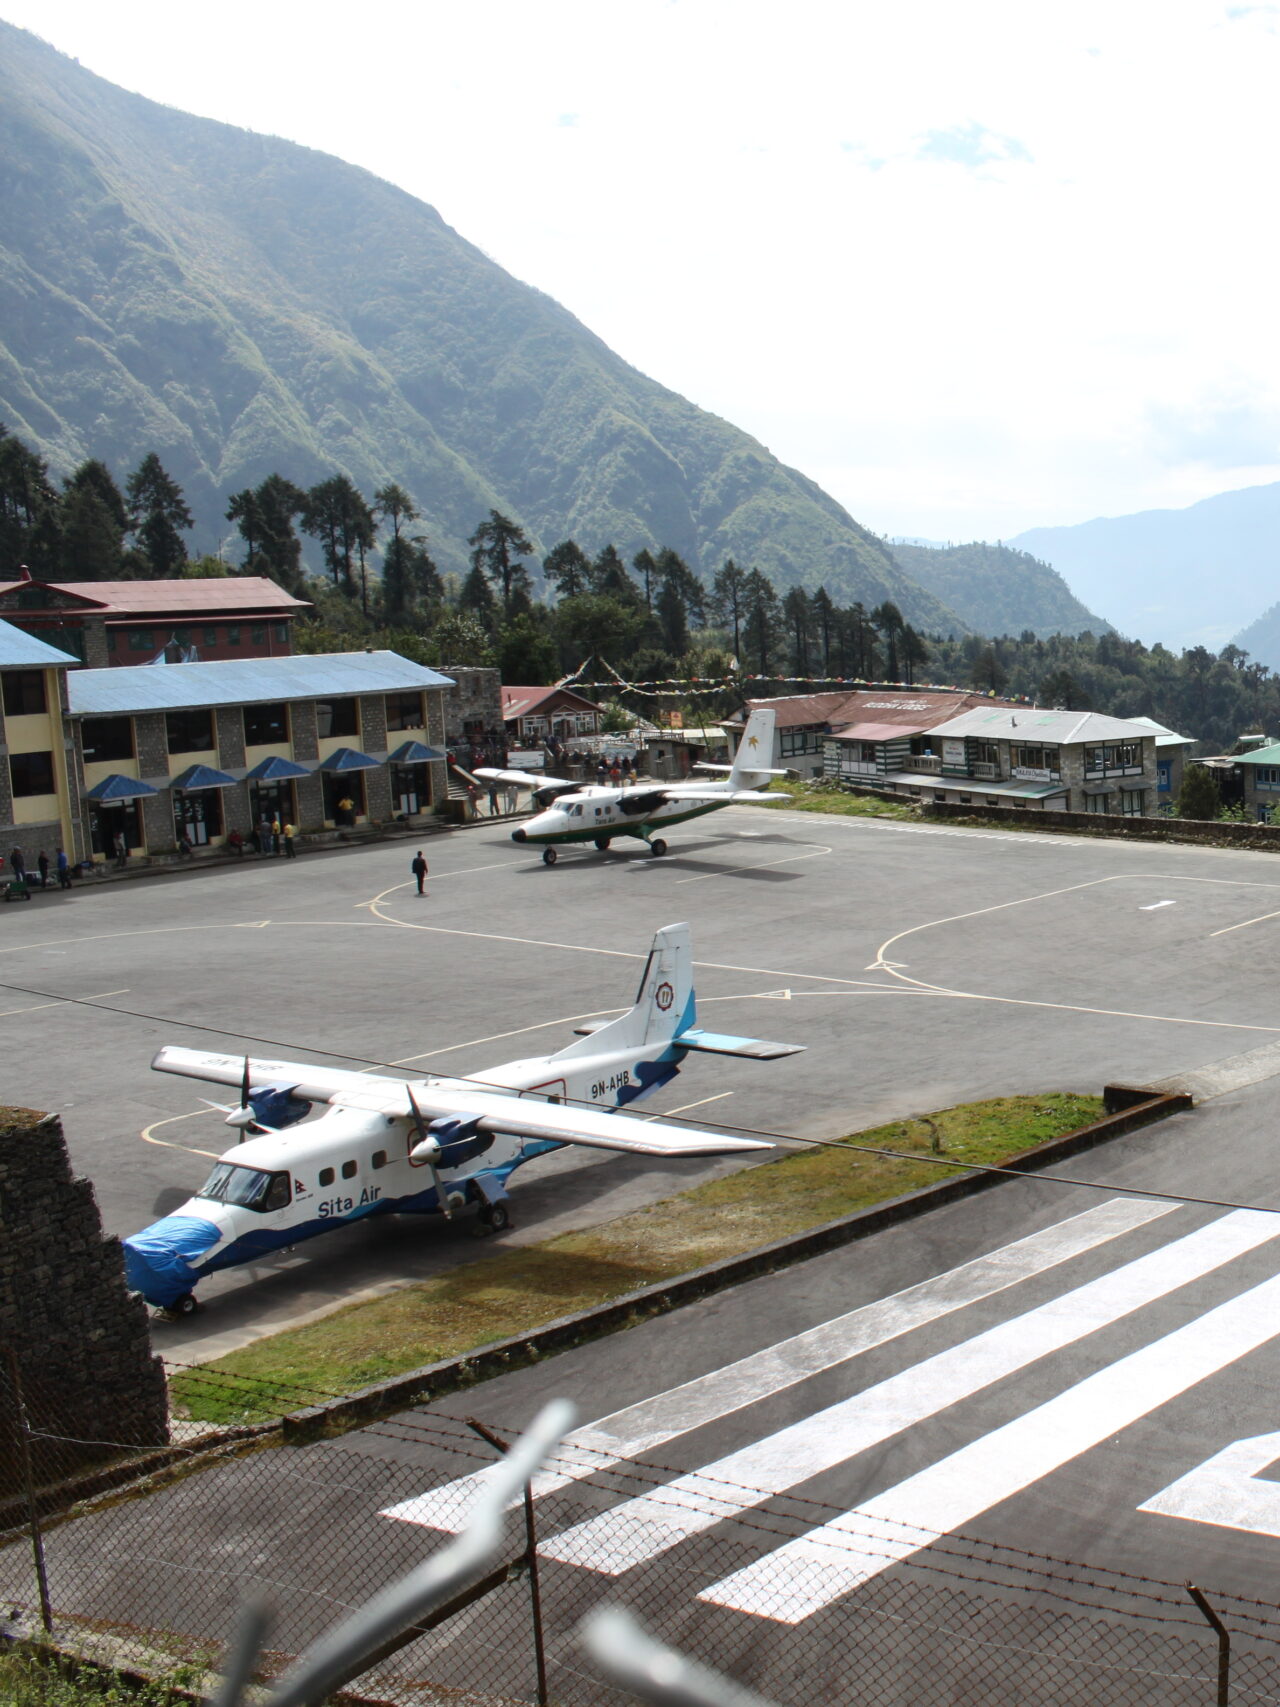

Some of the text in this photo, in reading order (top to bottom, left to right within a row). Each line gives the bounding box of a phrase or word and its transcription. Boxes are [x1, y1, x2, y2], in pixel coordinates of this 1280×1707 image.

[591, 1070, 630, 1099] 9N-AHB
[318, 1197, 353, 1219] Sita
[359, 1186, 381, 1206] Air
